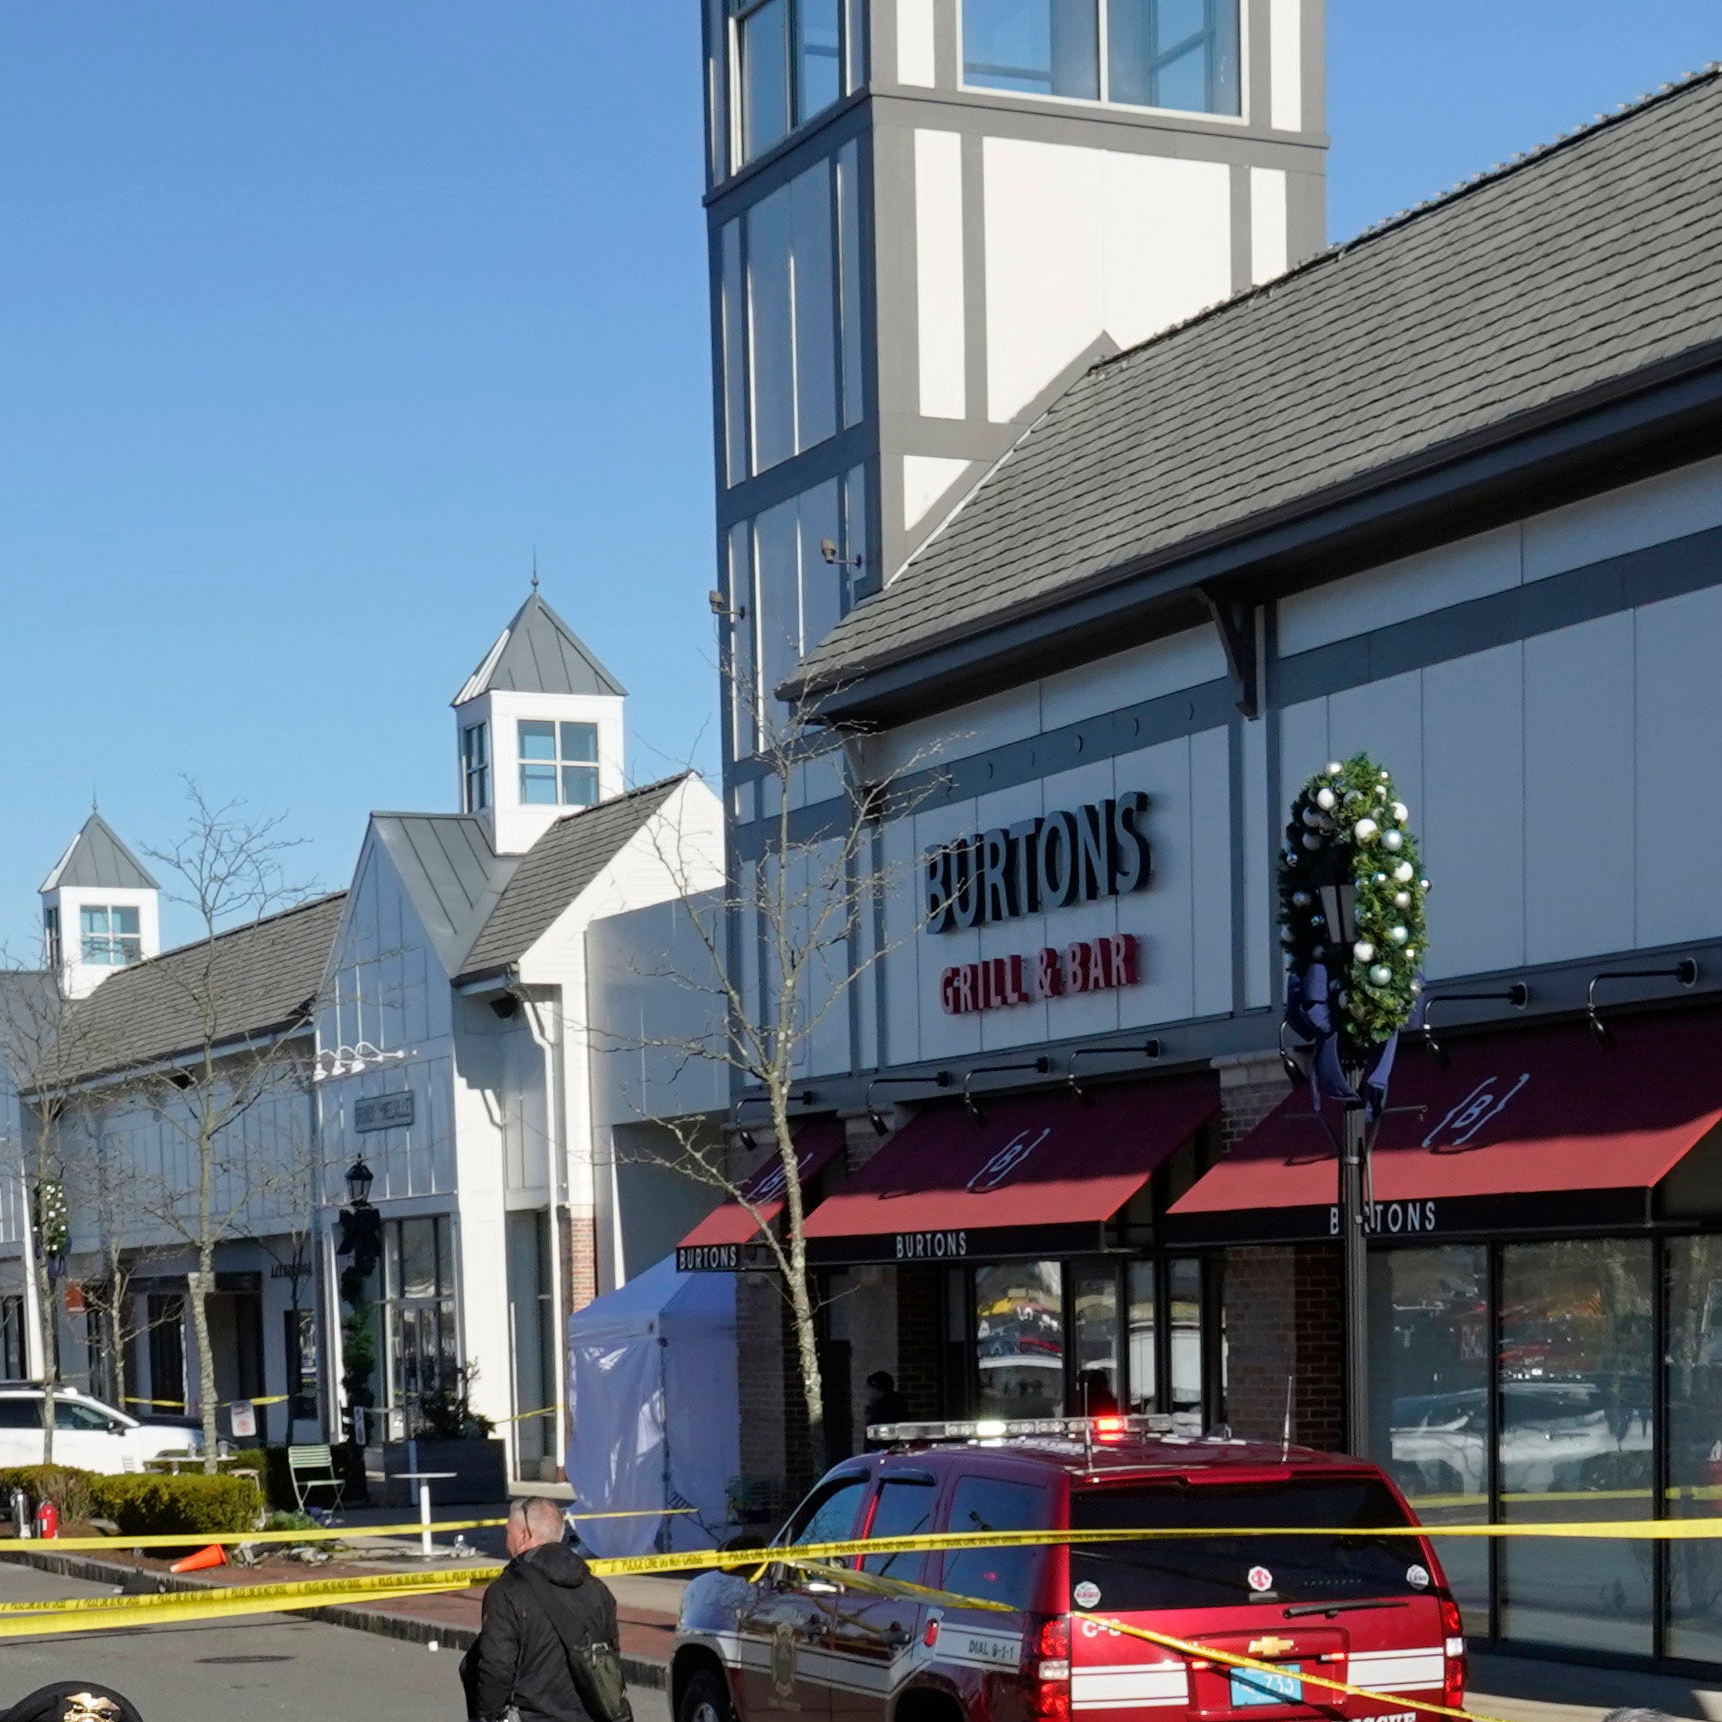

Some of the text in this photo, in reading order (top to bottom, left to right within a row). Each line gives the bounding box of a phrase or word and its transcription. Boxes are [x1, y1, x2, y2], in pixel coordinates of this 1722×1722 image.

[925, 791, 1151, 935] BURTONS
[940, 933, 1138, 1015] GRILL & BAR
[1330, 1201, 1436, 1235] BTONS
[679, 1247, 738, 1269] BURTONS
[895, 1232, 967, 1259] BURTONS
